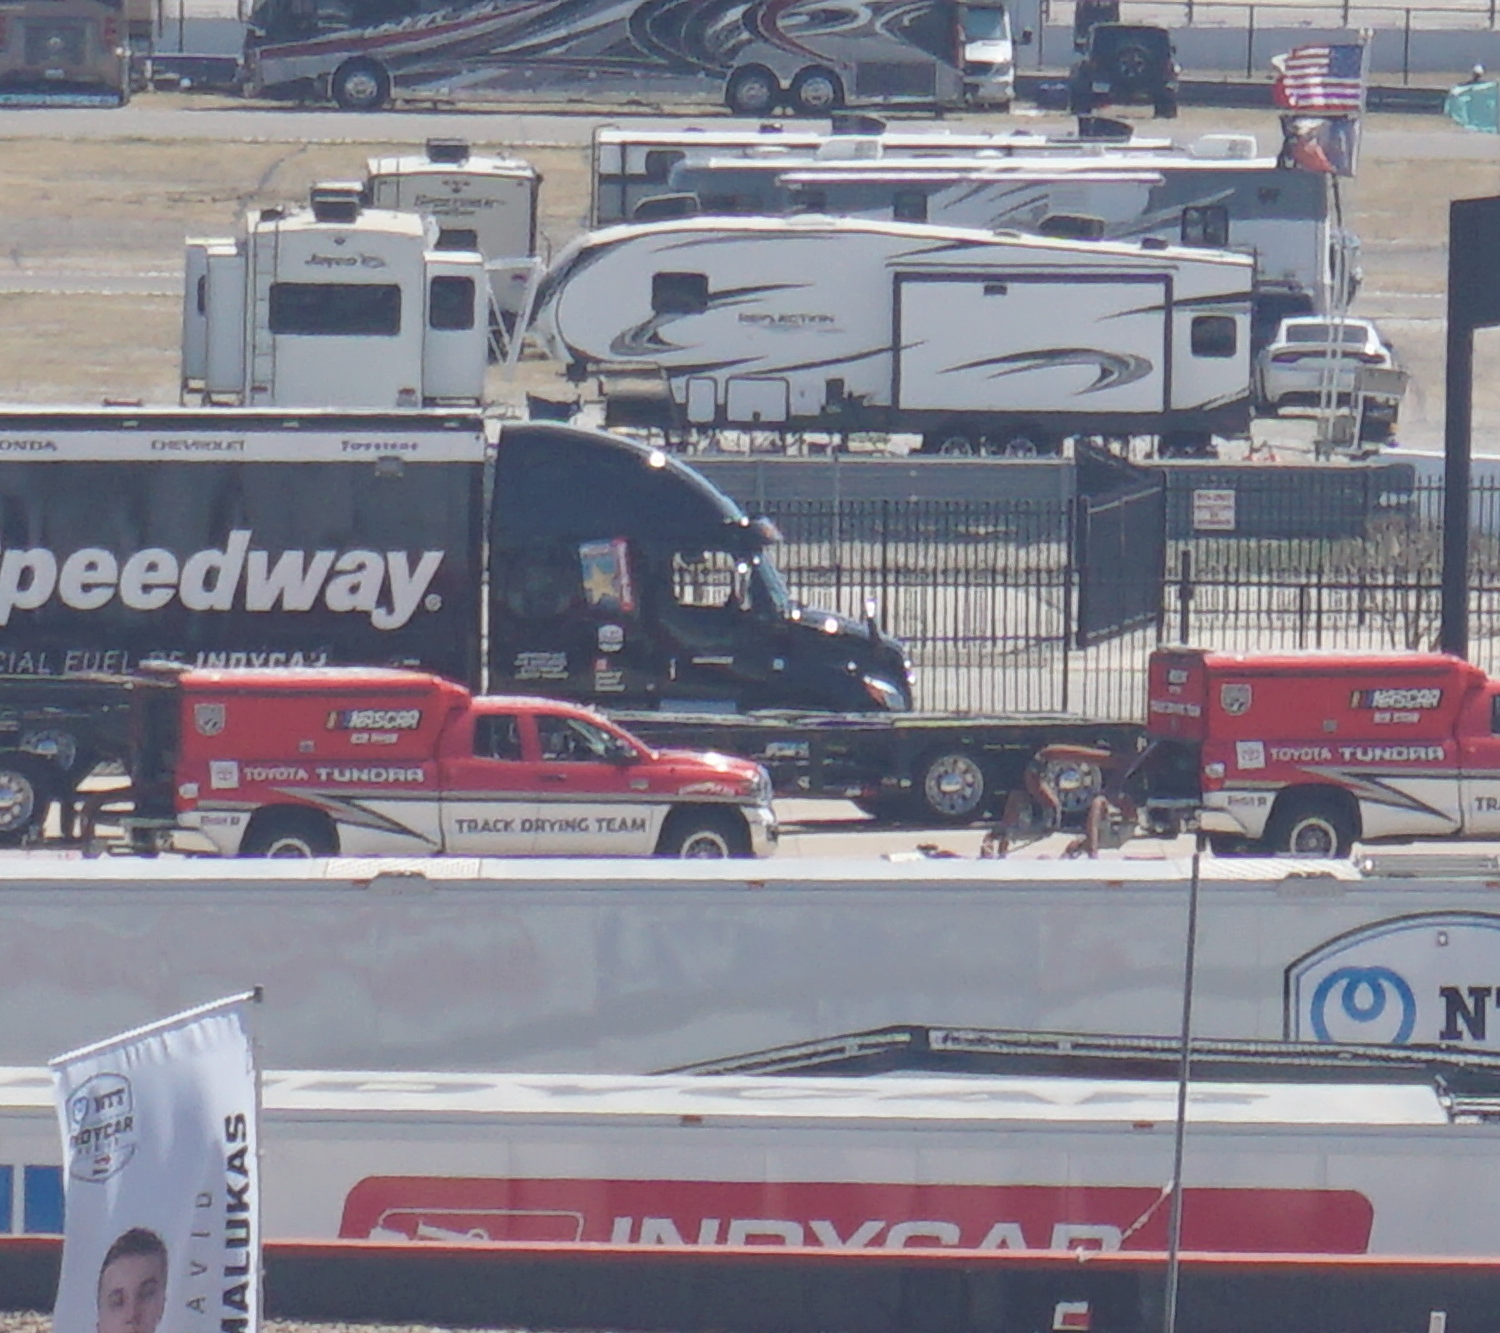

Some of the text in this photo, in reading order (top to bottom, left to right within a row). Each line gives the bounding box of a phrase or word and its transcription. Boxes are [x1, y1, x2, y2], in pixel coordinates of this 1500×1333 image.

[348, 710, 421, 730] NASCAR
[1269, 747, 1445, 762] TOYOTA TUNDRA
[242, 766, 425, 782] TOYOTA TUNDRA
[454, 818, 647, 834] TRACK DRYING TEAM
